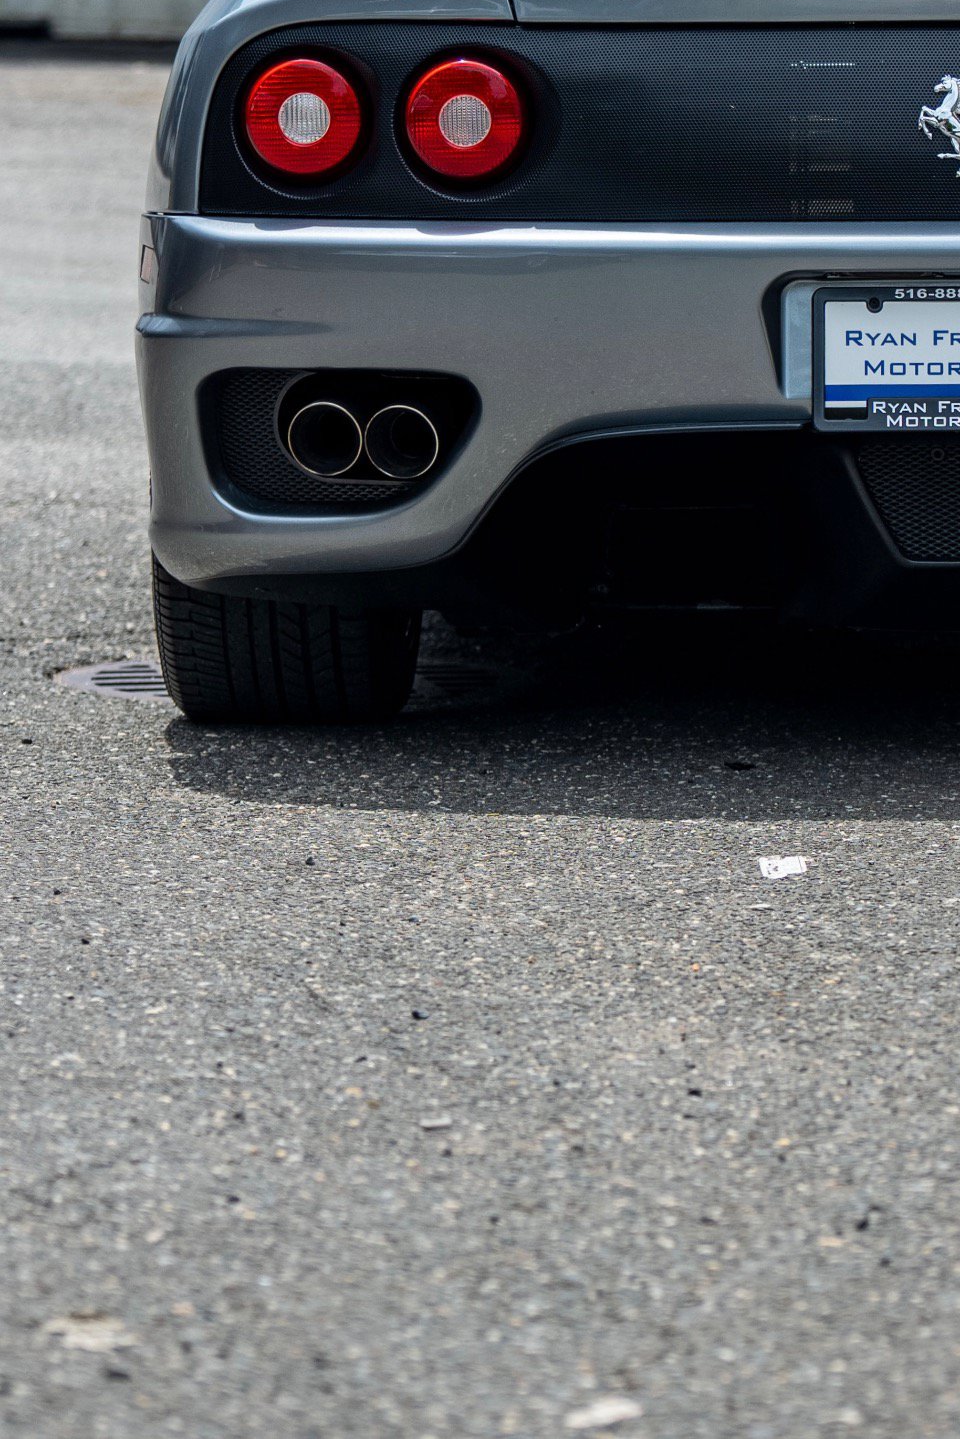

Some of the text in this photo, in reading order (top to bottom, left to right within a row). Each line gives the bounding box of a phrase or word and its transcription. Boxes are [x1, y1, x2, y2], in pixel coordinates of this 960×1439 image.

[845, 330, 917, 347] RYAN
[872, 401, 926, 414] RYAN
[886, 415, 960, 427] MOTOR
